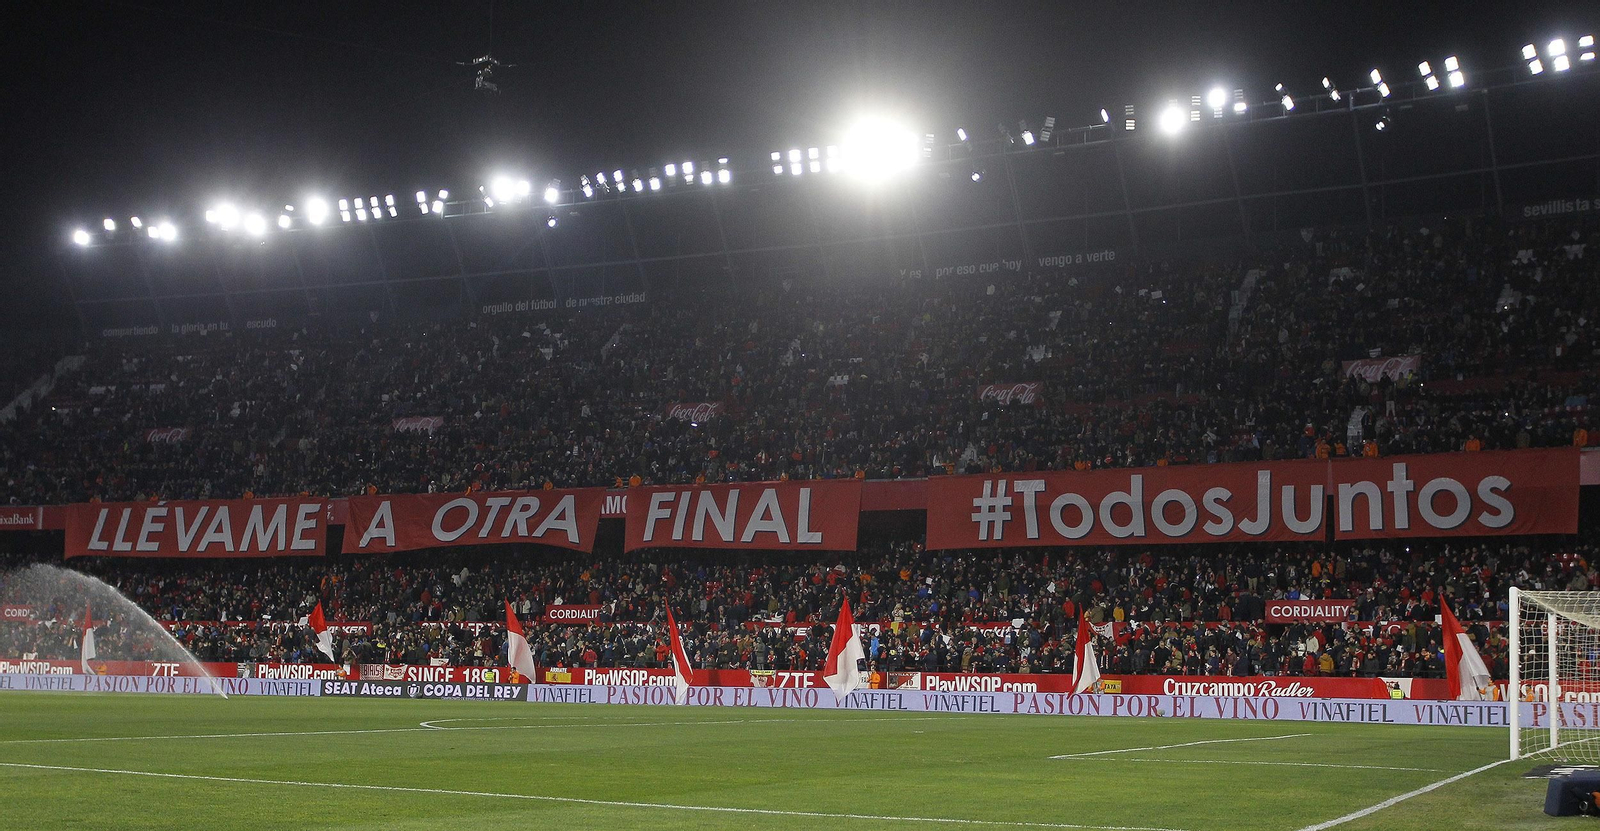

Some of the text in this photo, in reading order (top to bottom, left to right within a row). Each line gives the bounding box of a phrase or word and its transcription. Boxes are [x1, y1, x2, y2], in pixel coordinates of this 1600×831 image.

[957, 264, 976, 275] eso
[1038, 255, 1072, 268] vengo
[1075, 255, 1083, 264] a
[1086, 250, 1116, 263] verte
[482, 301, 513, 315] orgullo
[515, 300, 529, 311] del
[566, 297, 577, 308] de
[172, 323, 179, 333] la
[207, 322, 218, 331] en
[246, 317, 277, 329] escudo
[87, 487, 822, 552] LLÉVAME A OTRA FINAL
[4, 608, 30, 617] CORD
[1270, 605, 1349, 618] CORDIALITY
[407, 666, 454, 682] SINCE
[778, 672, 814, 688] ZTE
[145, 677, 175, 694] POR
[183, 678, 201, 694] EL
[325, 681, 402, 696] SEAT Ateca
[423, 683, 522, 699] COPA DEL REY
[926, 675, 1037, 693] PlayWSOP.com
[1163, 678, 1315, 698] Cruzcampo Radler
[686, 687, 731, 707] POR
[734, 688, 758, 707] EL
[768, 688, 818, 708] VINO
[1112, 694, 1158, 717] POR
[1172, 696, 1202, 718] EL
[1214, 697, 1280, 720] VINO
